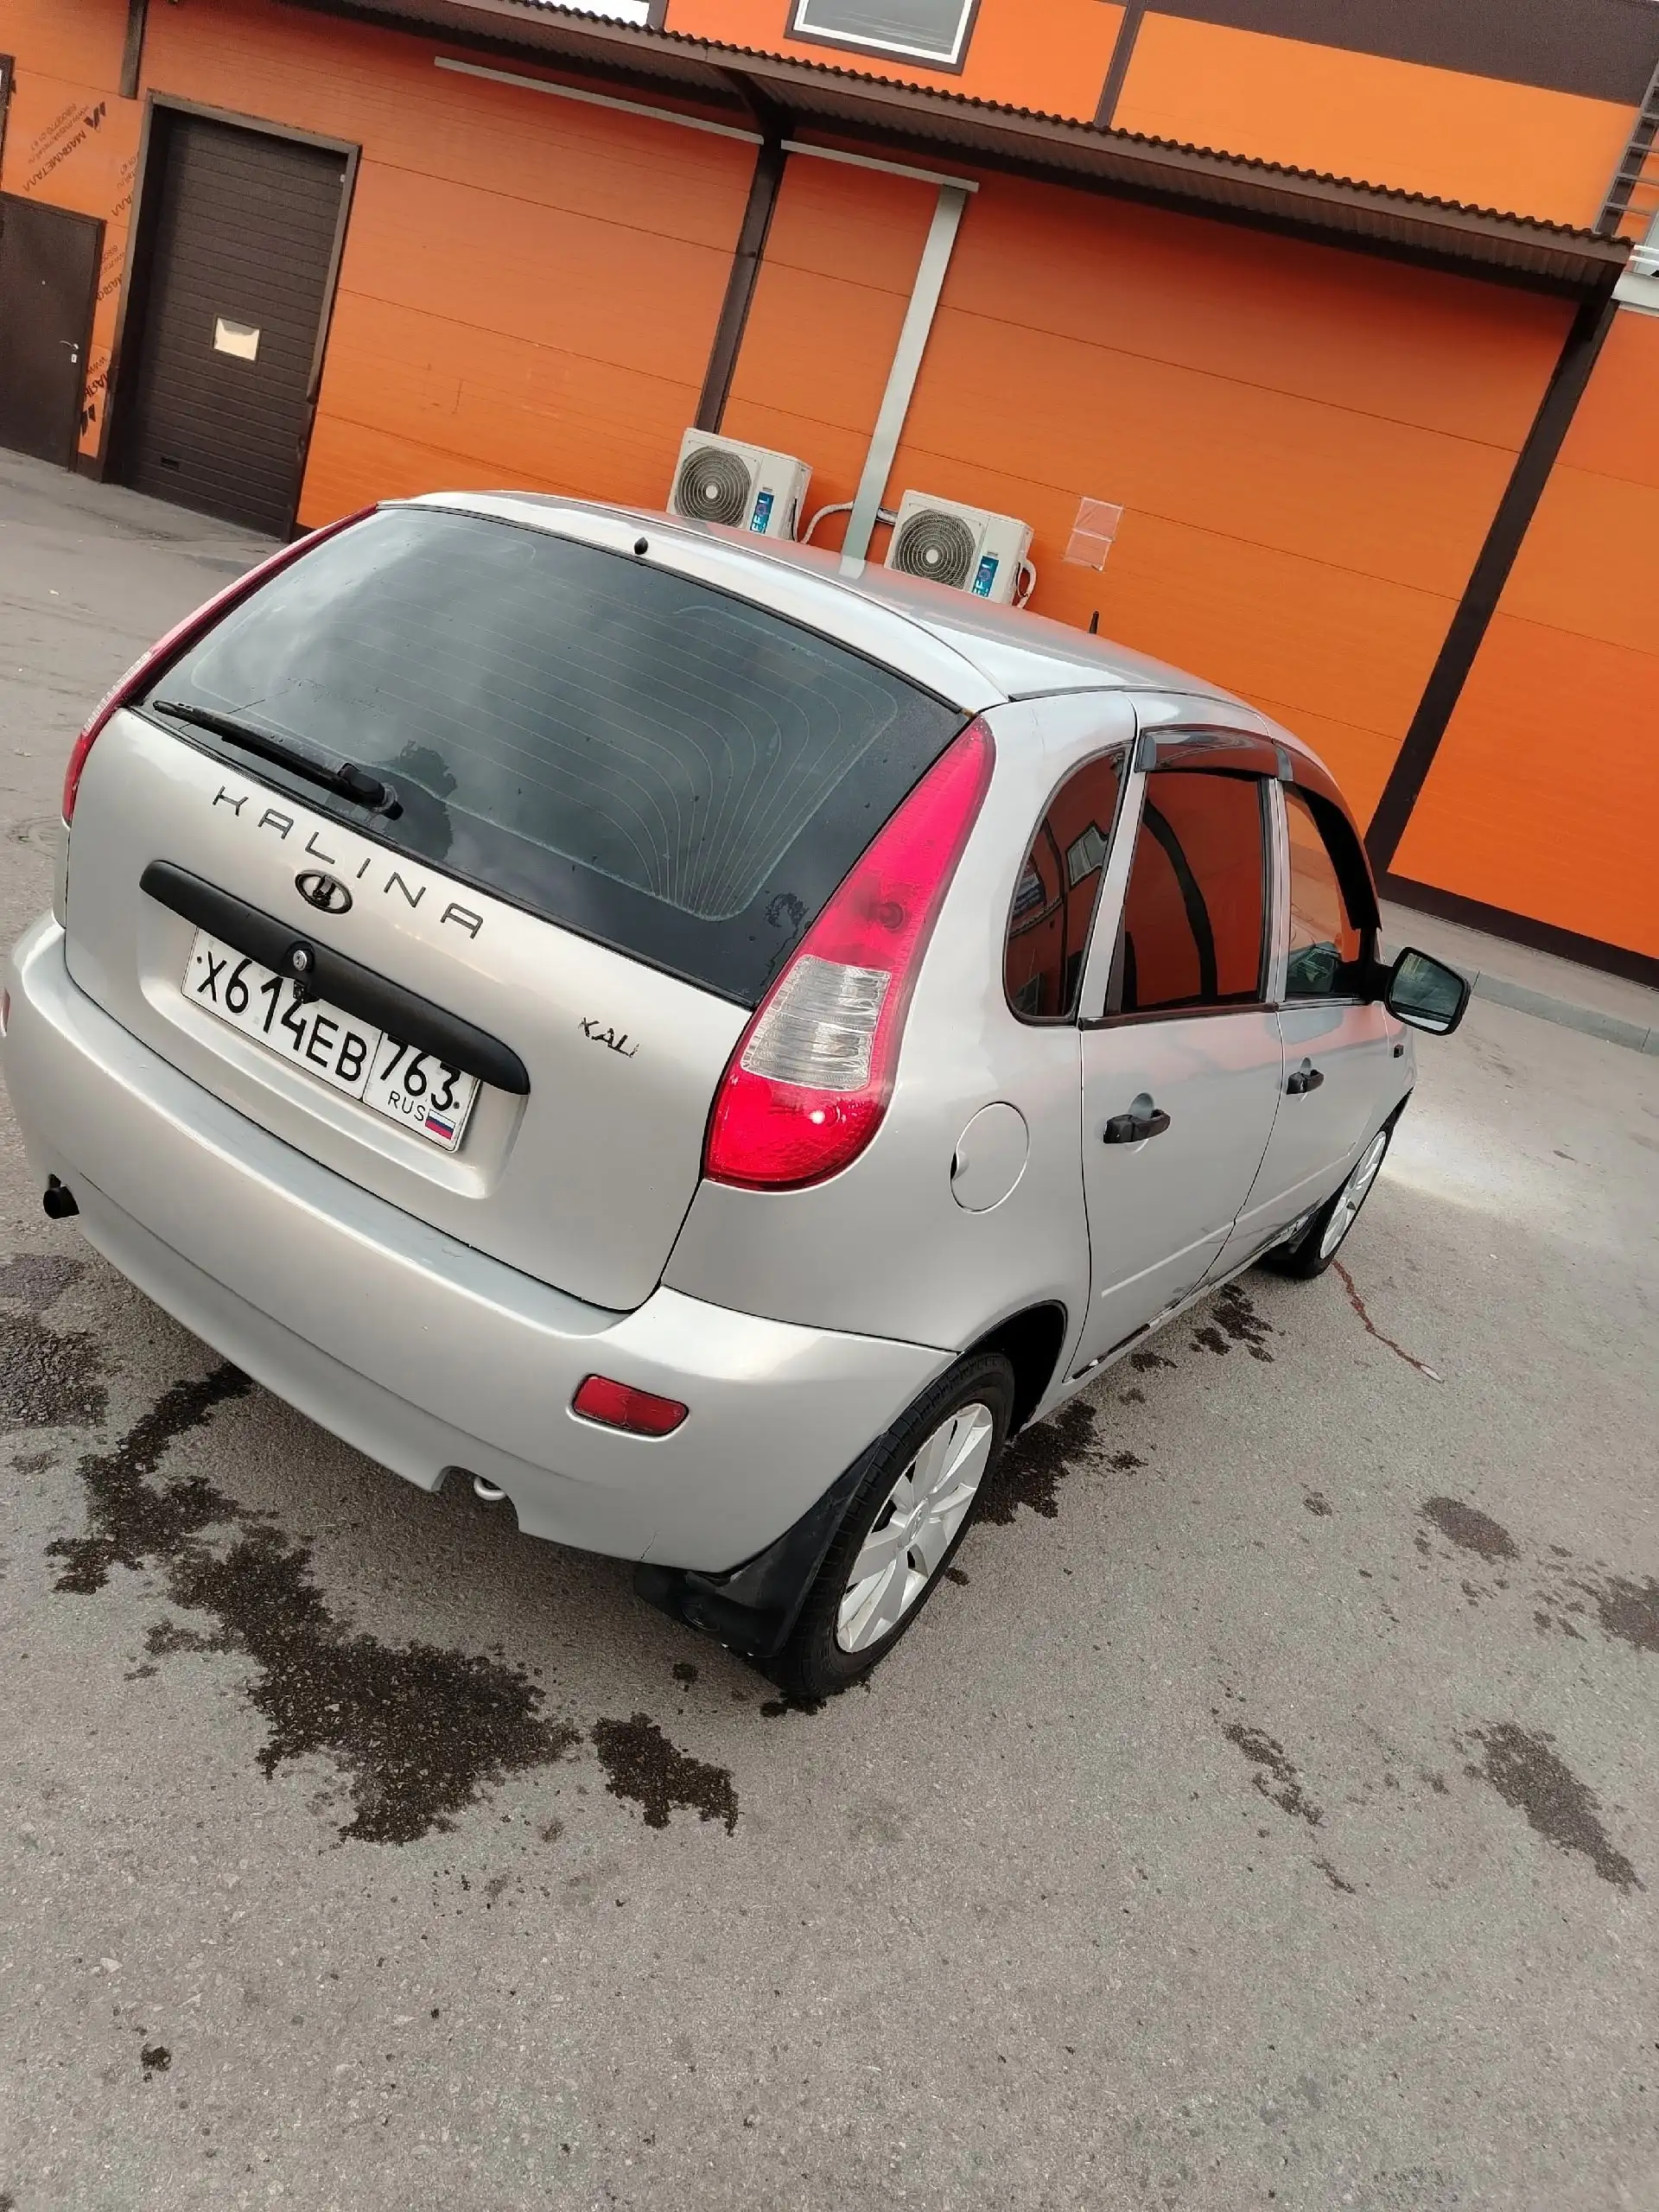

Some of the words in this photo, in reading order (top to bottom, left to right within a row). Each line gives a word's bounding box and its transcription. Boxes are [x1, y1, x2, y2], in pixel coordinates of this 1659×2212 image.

[212, 785, 484, 939] KALINA
[379, 1034, 462, 1111] 763
[388, 1090, 426, 1122] RUS
